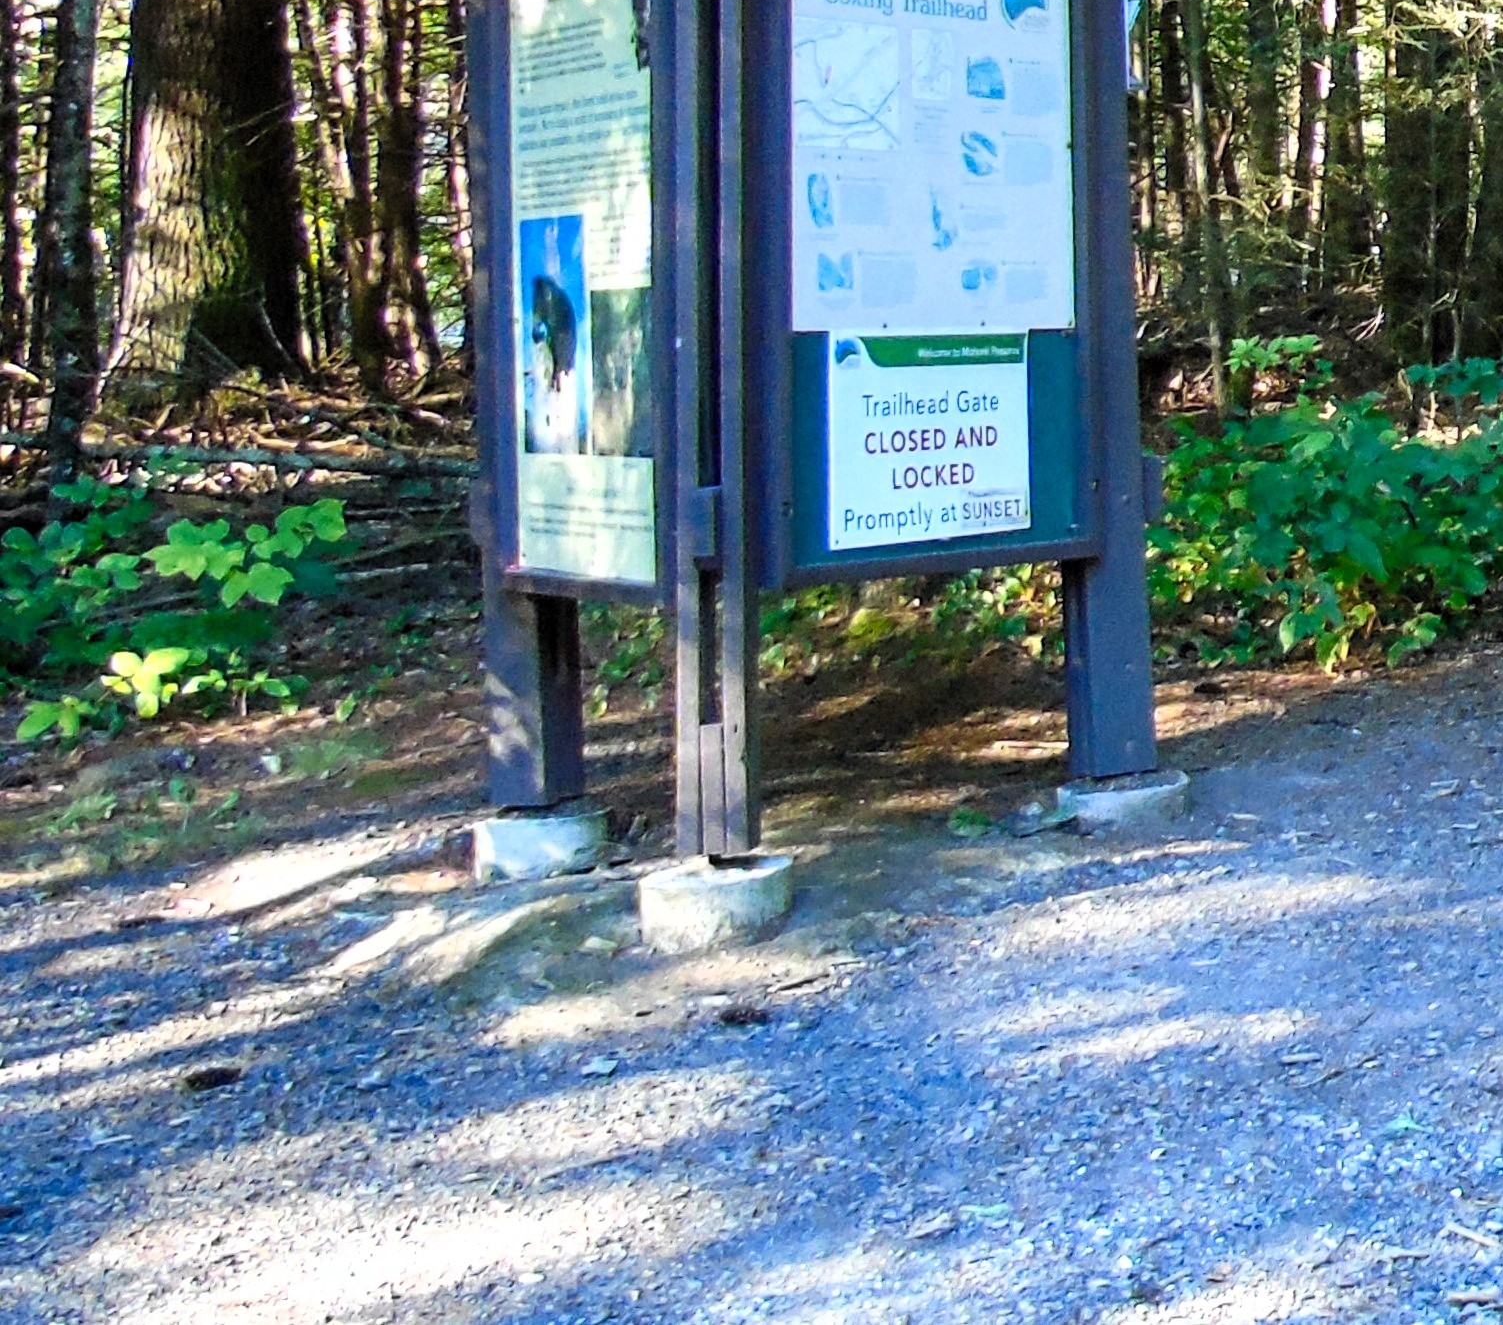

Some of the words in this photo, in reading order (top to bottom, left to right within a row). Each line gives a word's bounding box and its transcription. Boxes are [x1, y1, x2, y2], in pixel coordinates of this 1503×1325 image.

[862, 390, 949, 417] Trailhead
[957, 390, 999, 413] Gate
[865, 428, 946, 454] CLOSED
[955, 425, 998, 448] AND
[892, 463, 975, 489] LOCKED
[844, 502, 932, 535] Promptly
[941, 503, 957, 522] at
[963, 499, 1021, 520] SUNSET
